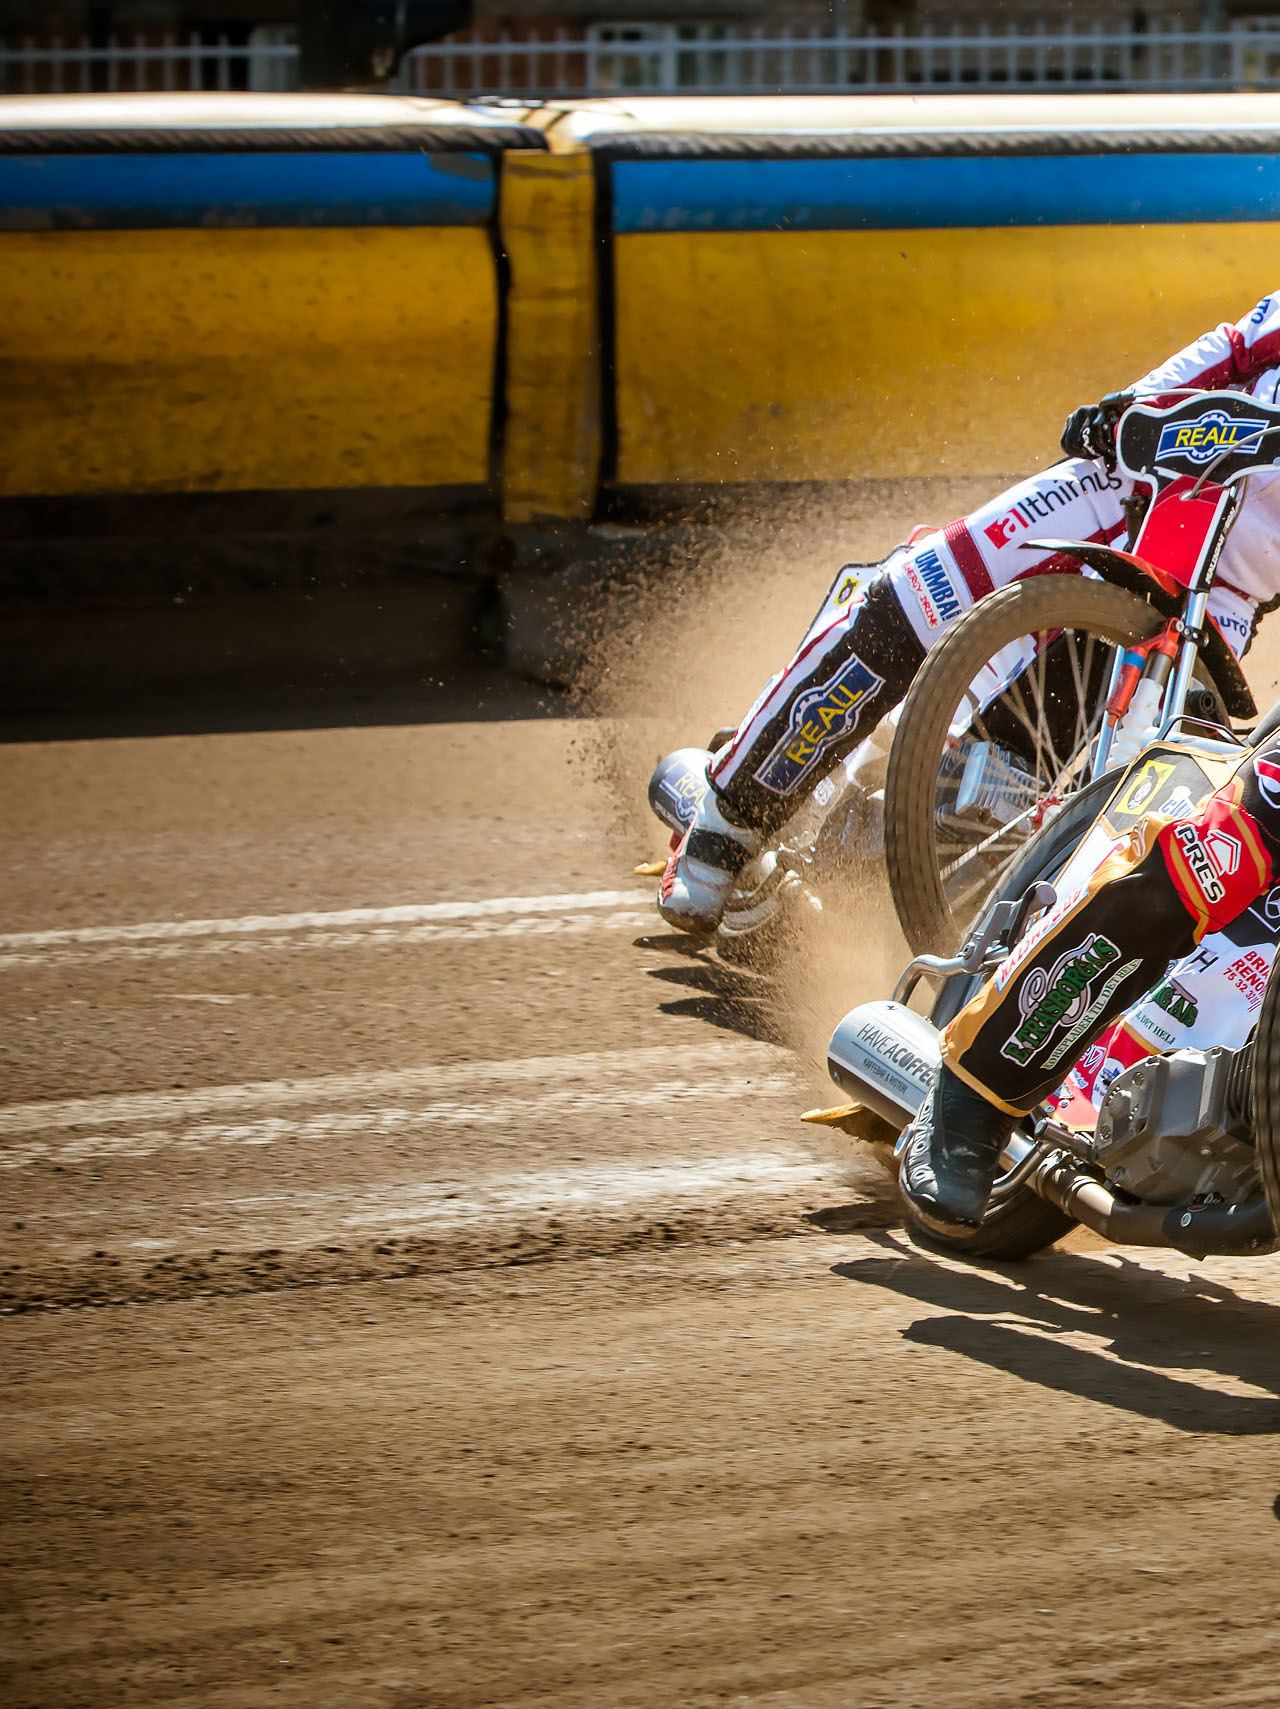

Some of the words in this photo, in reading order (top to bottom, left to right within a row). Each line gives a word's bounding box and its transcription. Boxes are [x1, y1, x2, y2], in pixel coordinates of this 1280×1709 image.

[1175, 426, 1241, 447] REALL
[786, 684, 864, 766] REALL
[1176, 825, 1225, 904] PRES
